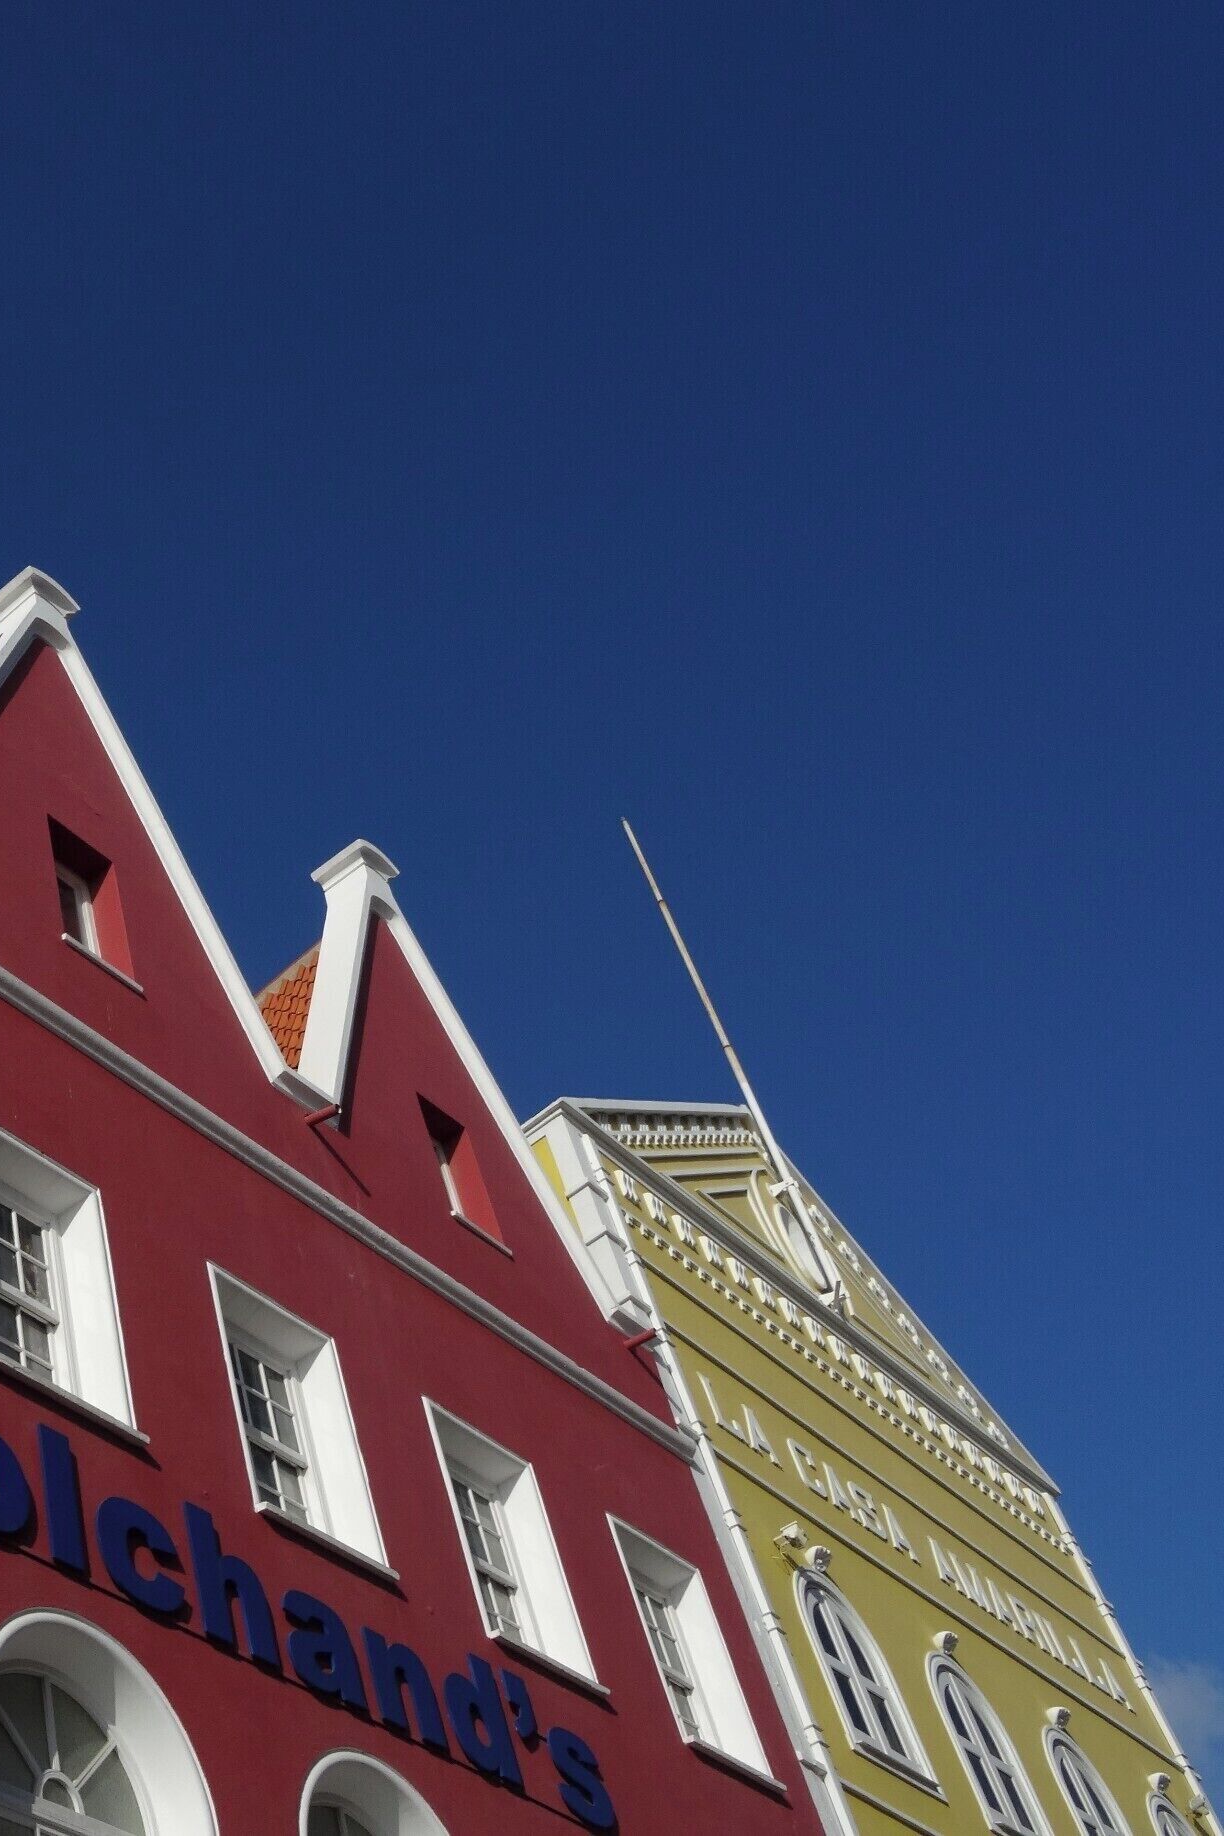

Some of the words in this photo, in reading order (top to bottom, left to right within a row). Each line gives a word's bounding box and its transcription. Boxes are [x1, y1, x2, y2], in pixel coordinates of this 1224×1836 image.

[696, 1371, 781, 1467] LA
[786, 1437, 920, 1564] CASA
[927, 1535, 1136, 1714] AMARILLA
